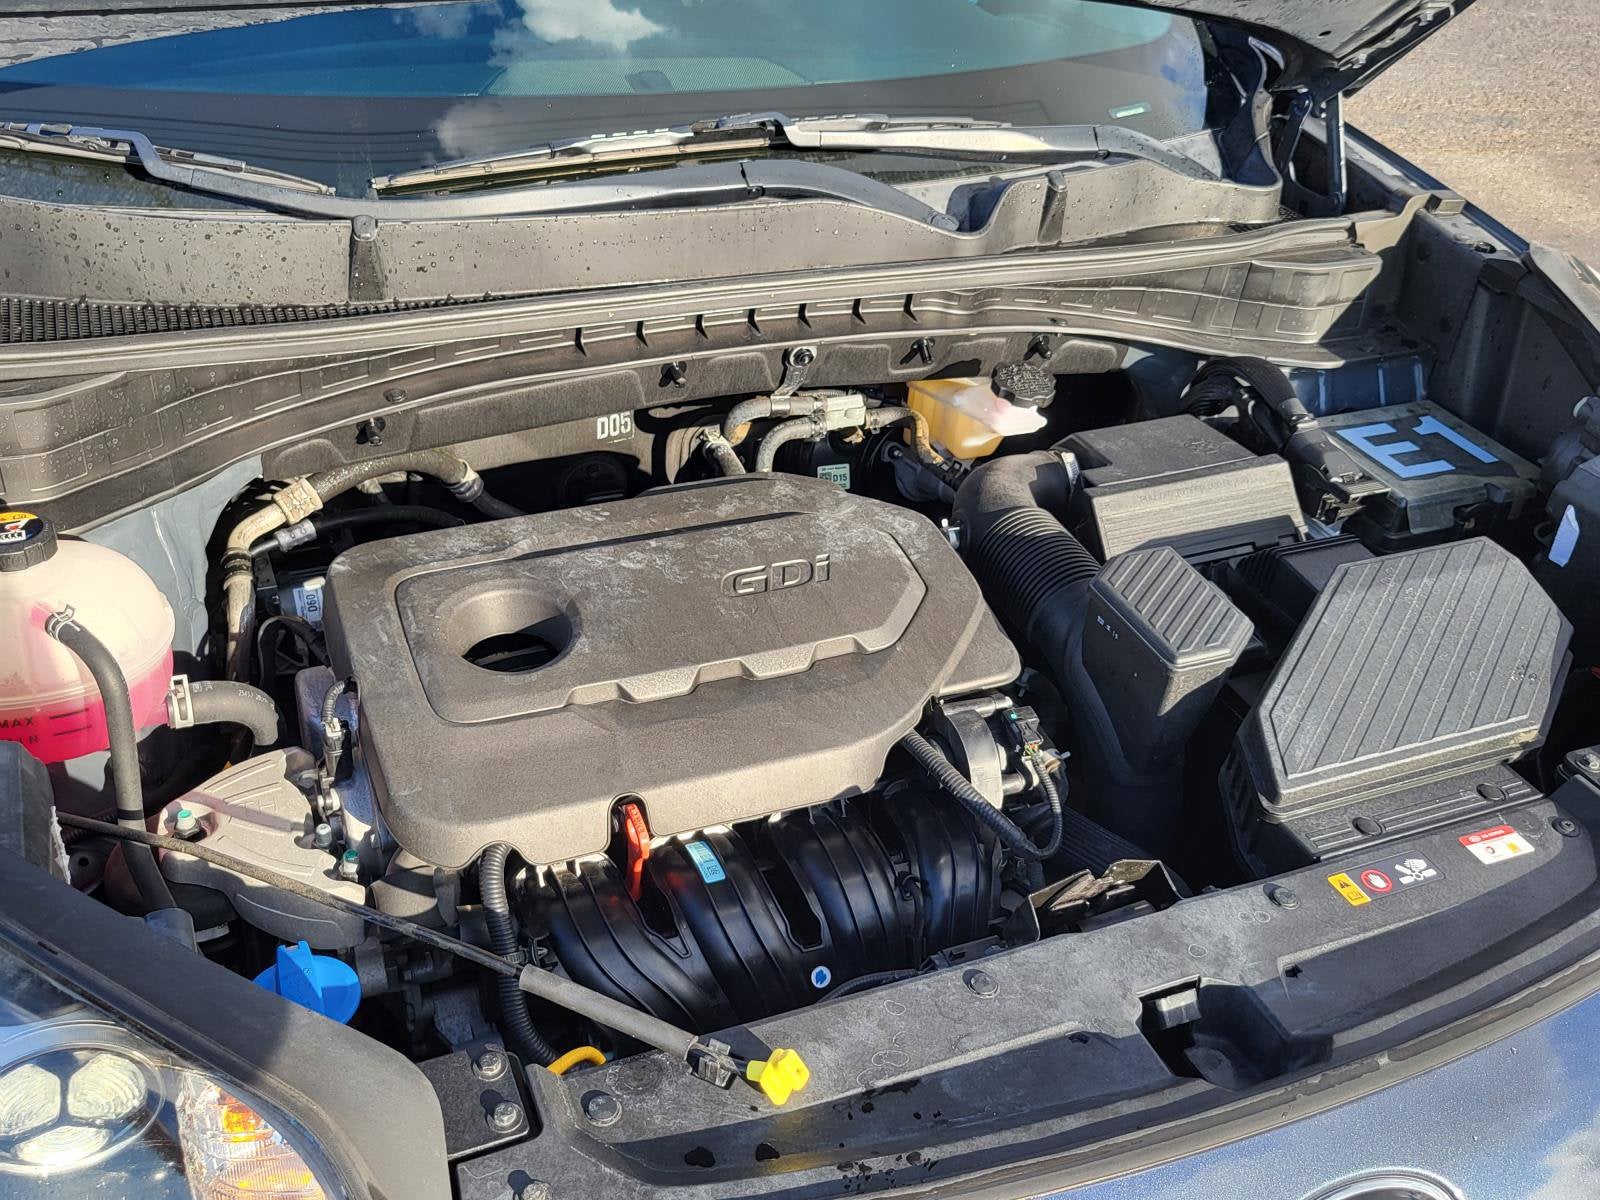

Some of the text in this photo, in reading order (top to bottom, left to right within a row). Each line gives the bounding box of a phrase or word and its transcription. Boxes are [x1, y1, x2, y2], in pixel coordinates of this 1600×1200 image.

[597, 411, 631, 440] D05
[1335, 415, 1500, 478] E1
[832, 473, 848, 482] D15
[721, 554, 830, 598] GDi
[305, 594, 318, 612] D60
[0, 717, 34, 729] MAX
